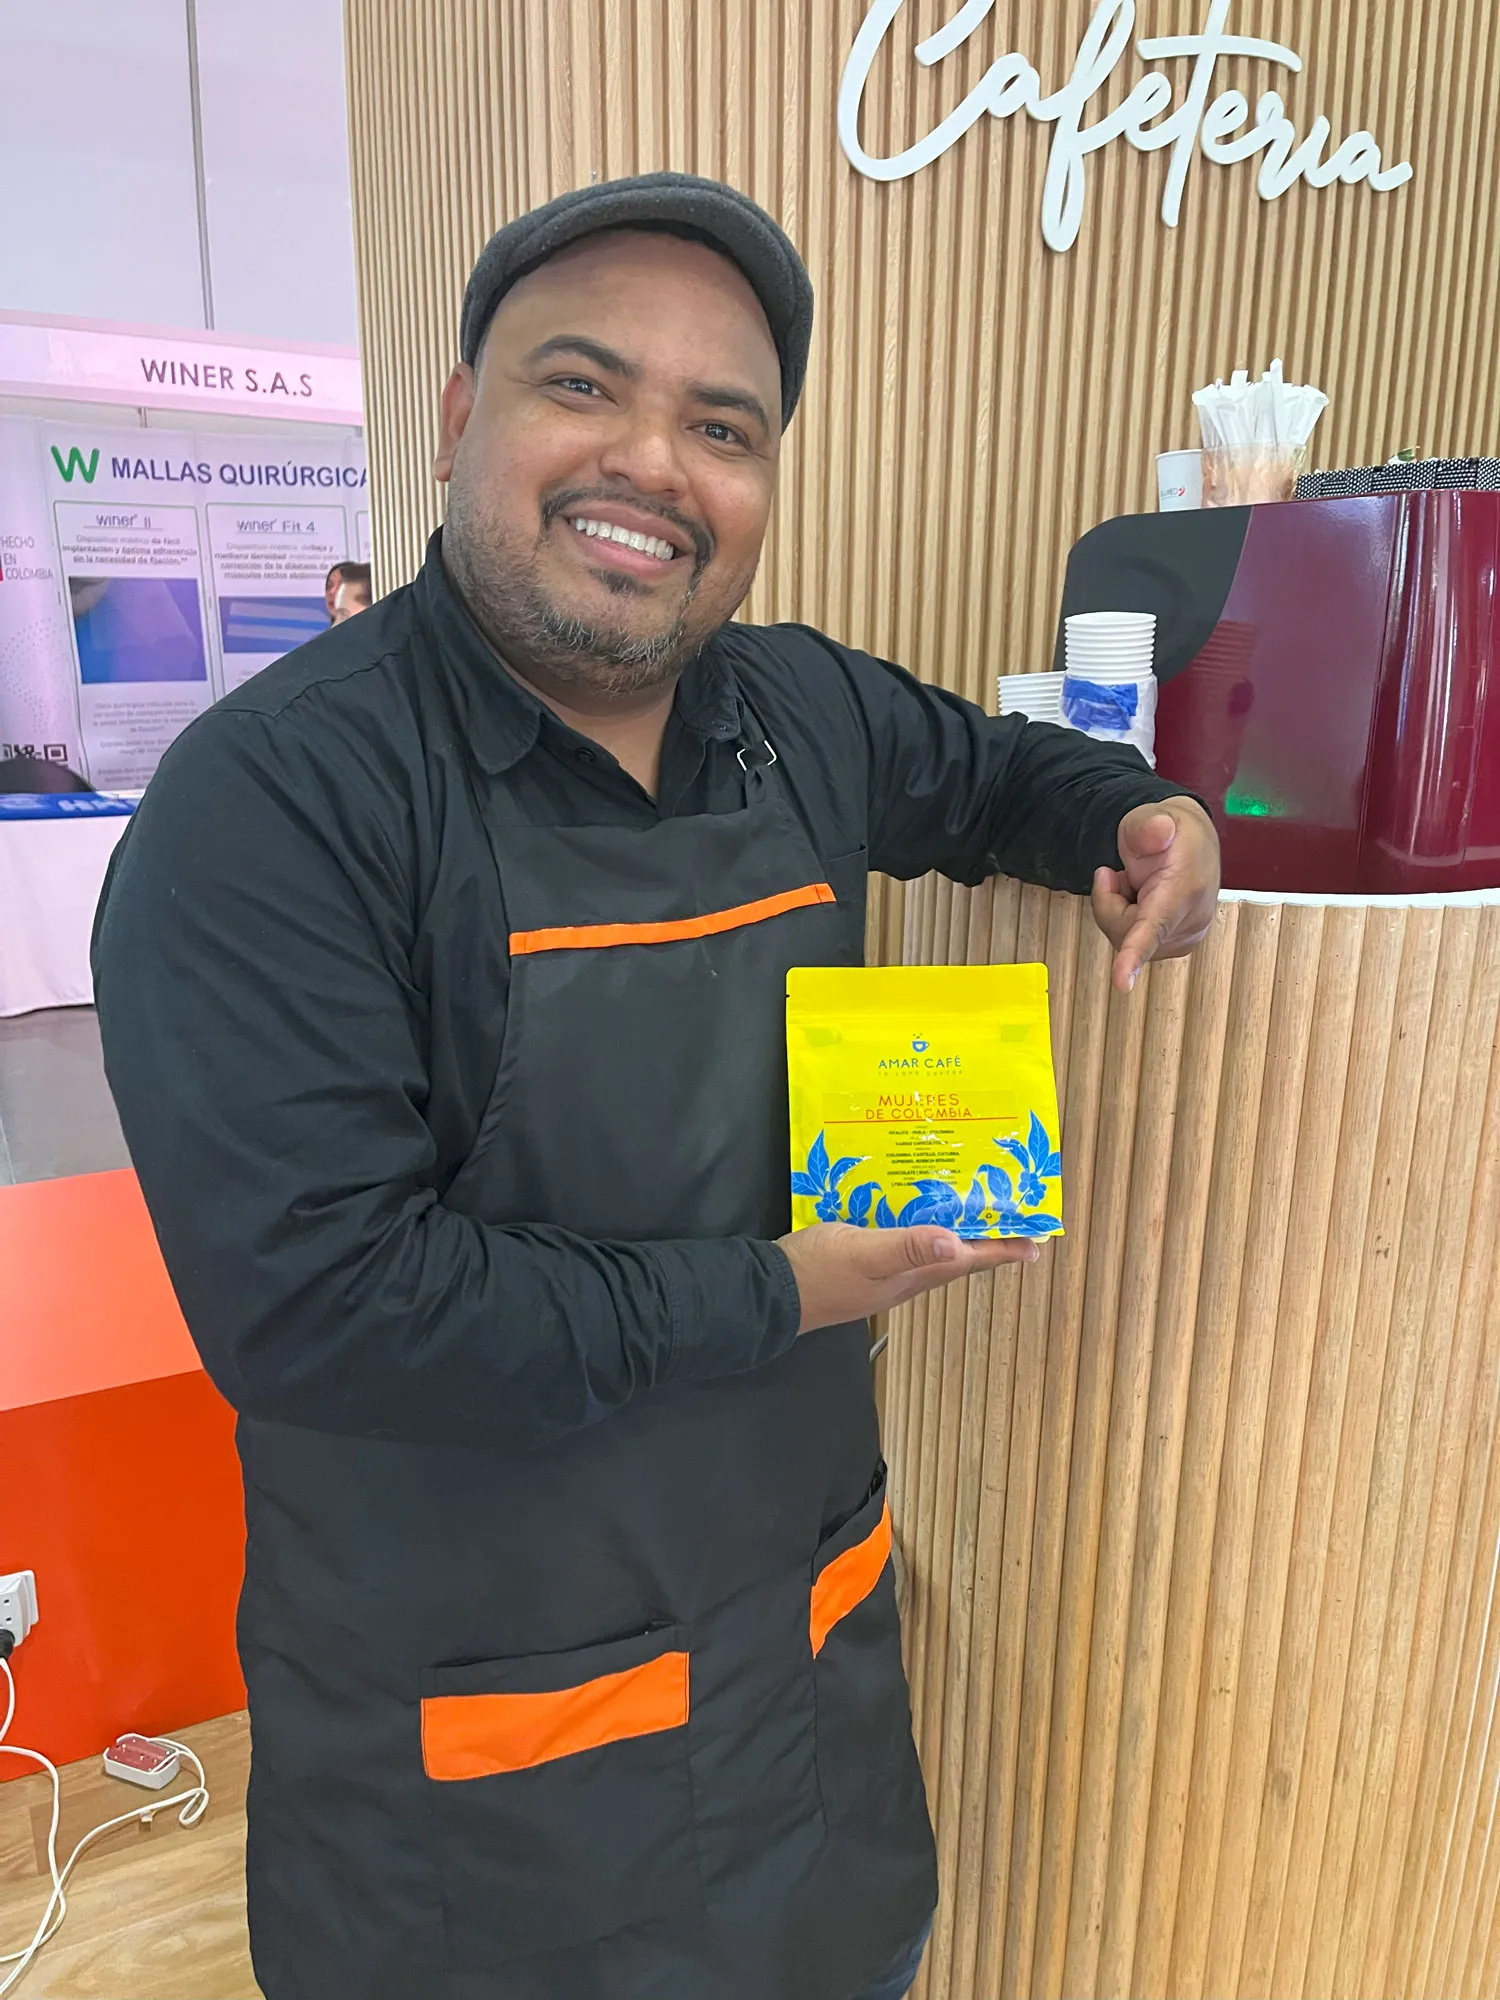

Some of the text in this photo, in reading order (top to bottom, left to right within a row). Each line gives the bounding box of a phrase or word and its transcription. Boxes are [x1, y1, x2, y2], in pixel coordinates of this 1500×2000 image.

[141, 358, 313, 397] WINER S.A.S
[111, 457, 212, 483] MALLAS
[306, 520, 315, 532] 4
[1, 535, 35, 549] HECHO
[3, 552, 17, 565] EN
[5, 567, 53, 580] COLOMBIA
[878, 1055, 962, 1069] AMAR CAFÉ
[879, 1093, 960, 1107] MUJERES
[866, 1107, 972, 1120] DE COLOMBIA
